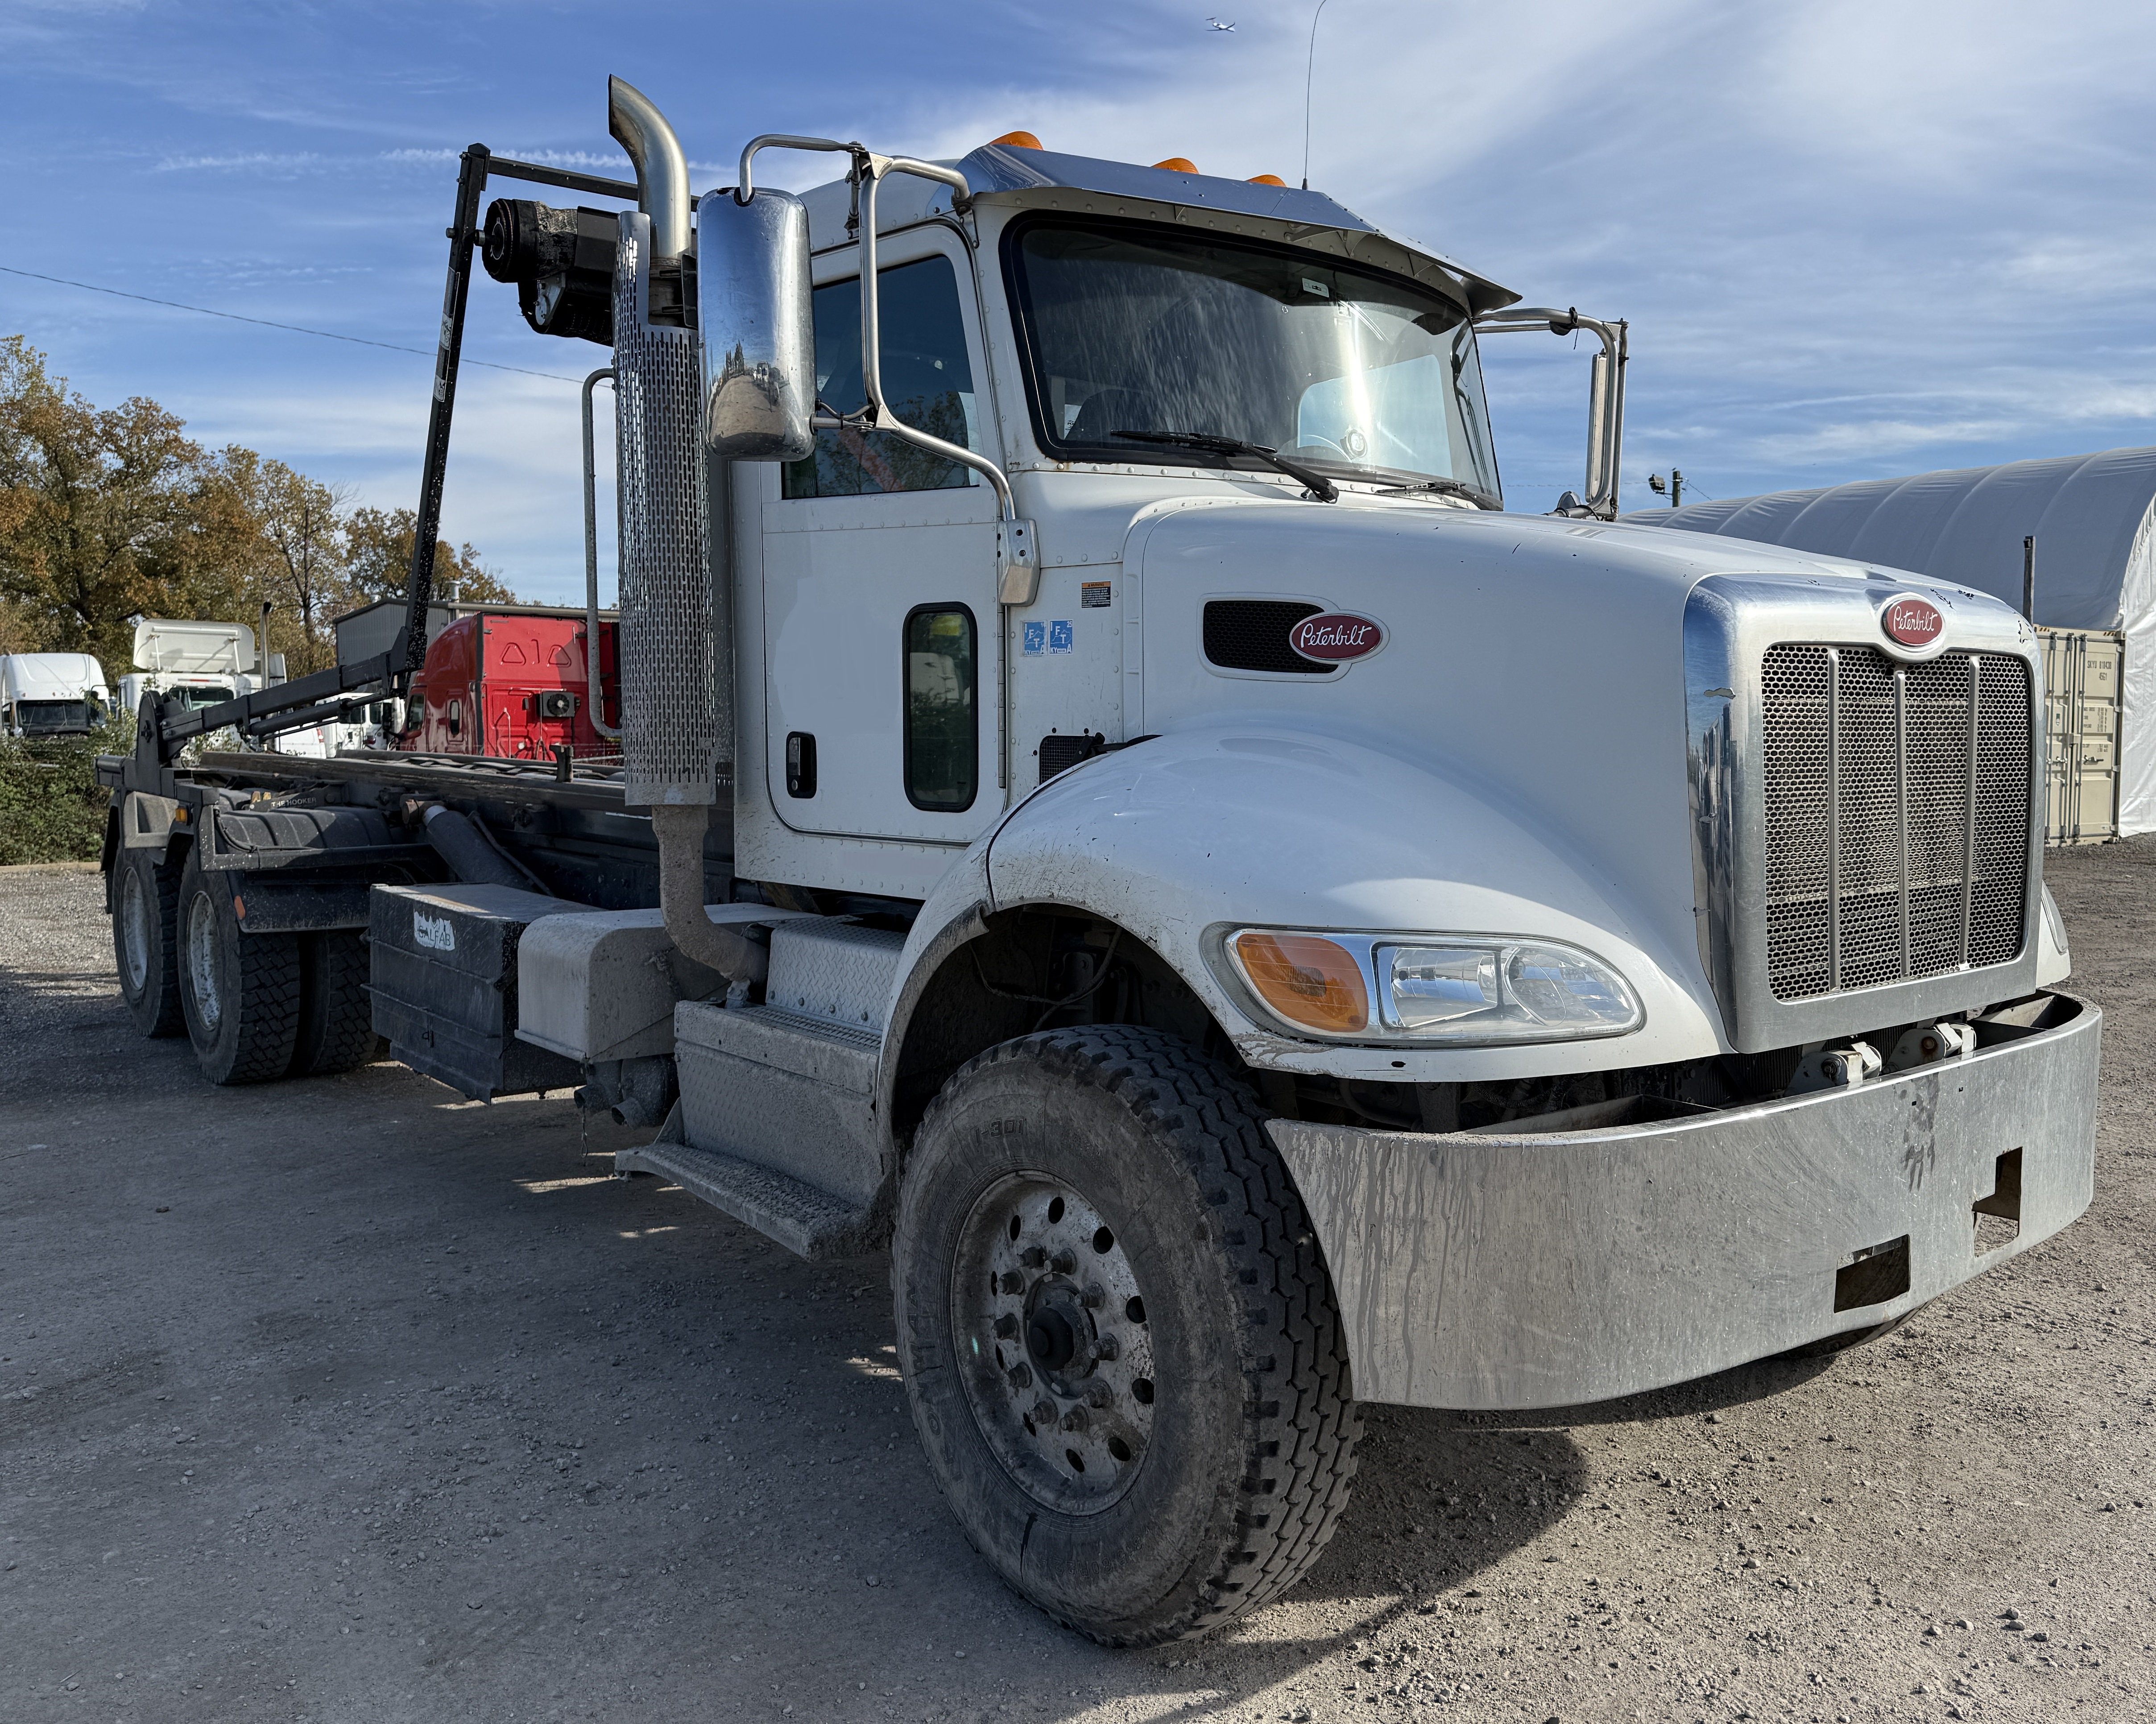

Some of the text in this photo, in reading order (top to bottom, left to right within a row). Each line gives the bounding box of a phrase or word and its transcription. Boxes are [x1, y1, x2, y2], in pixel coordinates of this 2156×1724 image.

[1893, 605, 1938, 632] Peterbilt
[1300, 623, 1372, 648] Peterbilt
[287, 797, 317, 806] HOOKER
